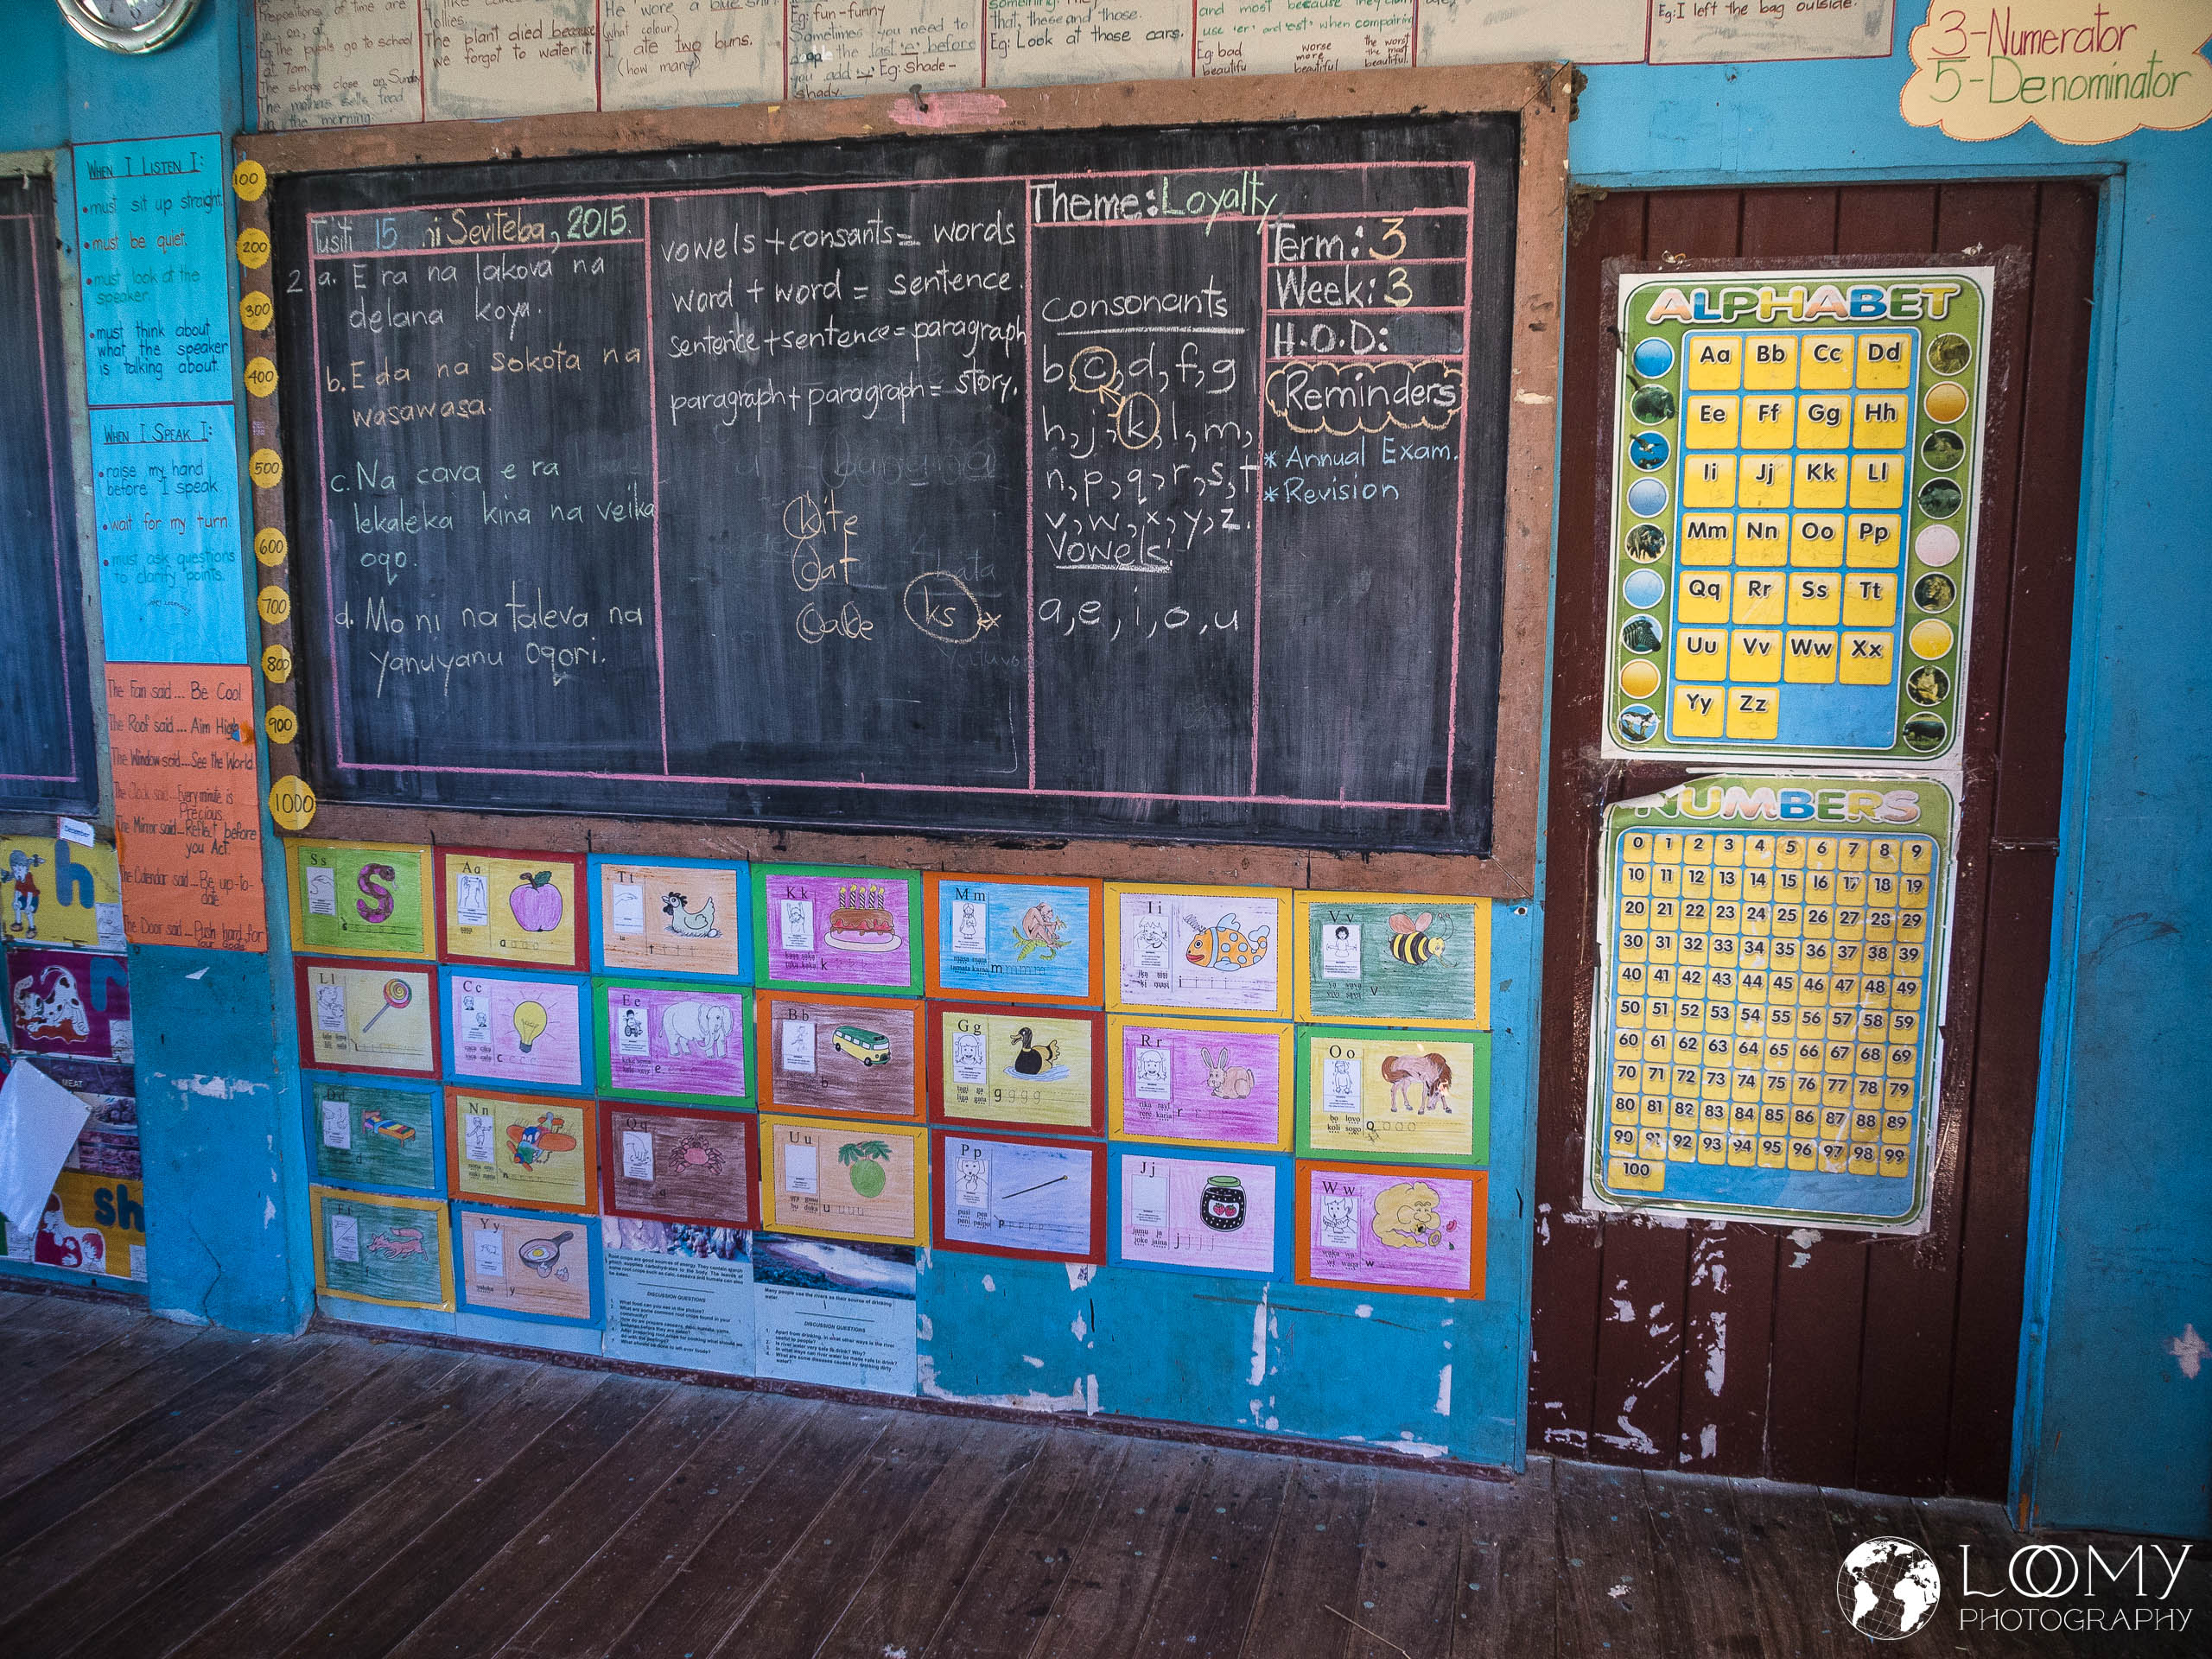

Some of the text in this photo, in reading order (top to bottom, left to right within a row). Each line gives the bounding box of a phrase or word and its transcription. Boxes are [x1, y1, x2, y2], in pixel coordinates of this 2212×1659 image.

[426, 30, 454, 49] The
[465, 25, 499, 54] plant
[508, 21, 544, 41] died
[634, 39, 658, 56] ate
[676, 35, 702, 54] two
[715, 33, 753, 49] buns.
[1016, 29, 1052, 48] Look
[1066, 28, 1082, 44] at
[1090, 26, 1131, 44] those
[1147, 29, 1185, 41] cars.
[233, 173, 258, 186] 100
[1030, 170, 1278, 236] Theme: Loyalty
[92, 229, 187, 254] must be quiet.
[243, 242, 267, 253] 200
[375, 217, 397, 250] 15
[422, 217, 441, 248] ni
[661, 223, 756, 264] vowels
[934, 208, 1017, 246] words
[1269, 218, 1407, 265] Term: 3
[286, 270, 303, 292] 2
[383, 269, 408, 285] ra
[429, 267, 457, 282] na
[574, 257, 604, 274] na
[775, 268, 842, 305] word
[1276, 264, 1413, 309] Week: 3
[245, 302, 270, 317] 300
[349, 287, 541, 341] delana koya.
[1647, 284, 1961, 324] ALPHABET
[912, 315, 1027, 362] paragraph
[1700, 343, 1900, 365] Aa Bb Cc Dd
[248, 370, 274, 384] 400
[326, 366, 346, 391] b.
[437, 362, 469, 378] na
[604, 346, 640, 365] na
[808, 371, 925, 426] paragraph
[1285, 370, 1457, 411] Reminders
[1700, 403, 1896, 427] Ee Ff Gg Hh
[254, 461, 279, 475] 500
[1286, 435, 1459, 470] Annual Exam.
[330, 460, 560, 493] c. Na cava e ra
[1284, 472, 1400, 505] Revision
[110, 518, 132, 531] wait
[143, 512, 162, 530] for
[170, 518, 186, 534] my
[354, 498, 453, 534] lekaleka
[483, 490, 531, 526] kina
[551, 504, 583, 524] na
[259, 538, 283, 555] 600
[263, 598, 287, 615] 700
[335, 580, 643, 633] d. Mo ni na taleva na
[1688, 580, 1881, 601] Qq Rr Ss Tt
[267, 657, 289, 671] 800
[190, 680, 208, 701] Be
[268, 718, 292, 733] 900
[275, 793, 314, 814] 1000
[54, 839, 94, 909] h
[1624, 935, 1918, 961] 30 31 32 33 34 35 36 37 38 39
[1624, 1163, 1650, 1176] 100
[93, 1185, 144, 1234] sh
